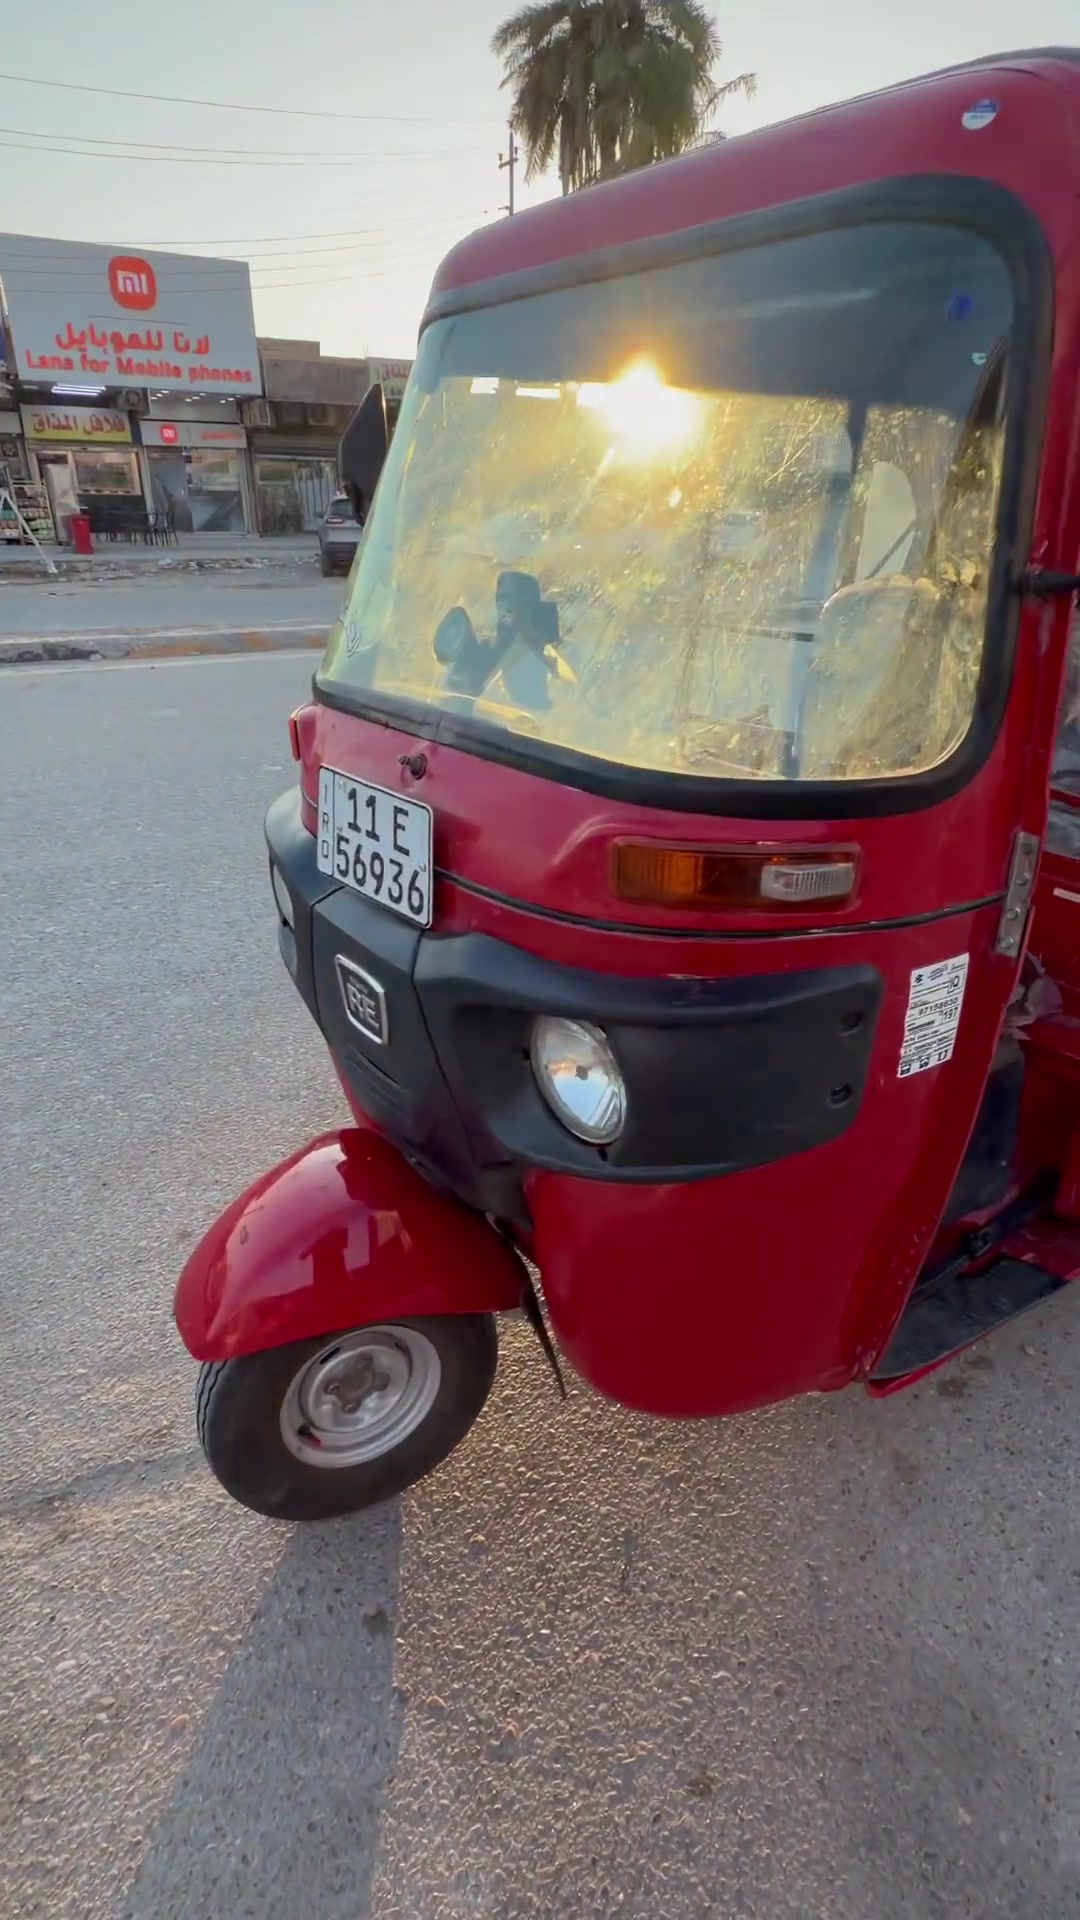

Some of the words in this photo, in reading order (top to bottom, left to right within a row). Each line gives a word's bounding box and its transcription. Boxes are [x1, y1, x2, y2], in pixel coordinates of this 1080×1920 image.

[55, 322, 163, 355] للموبايل
[173, 331, 210, 355] لانا
[25, 350, 75, 372] Lana
[79, 350, 109, 374] for
[115, 355, 183, 379] Mobile
[188, 363, 254, 384] phones
[348, 787, 381, 842] 11
[393, 804, 410, 857] E
[336, 833, 425, 916] 56936
[346, 982, 380, 1029] RE
